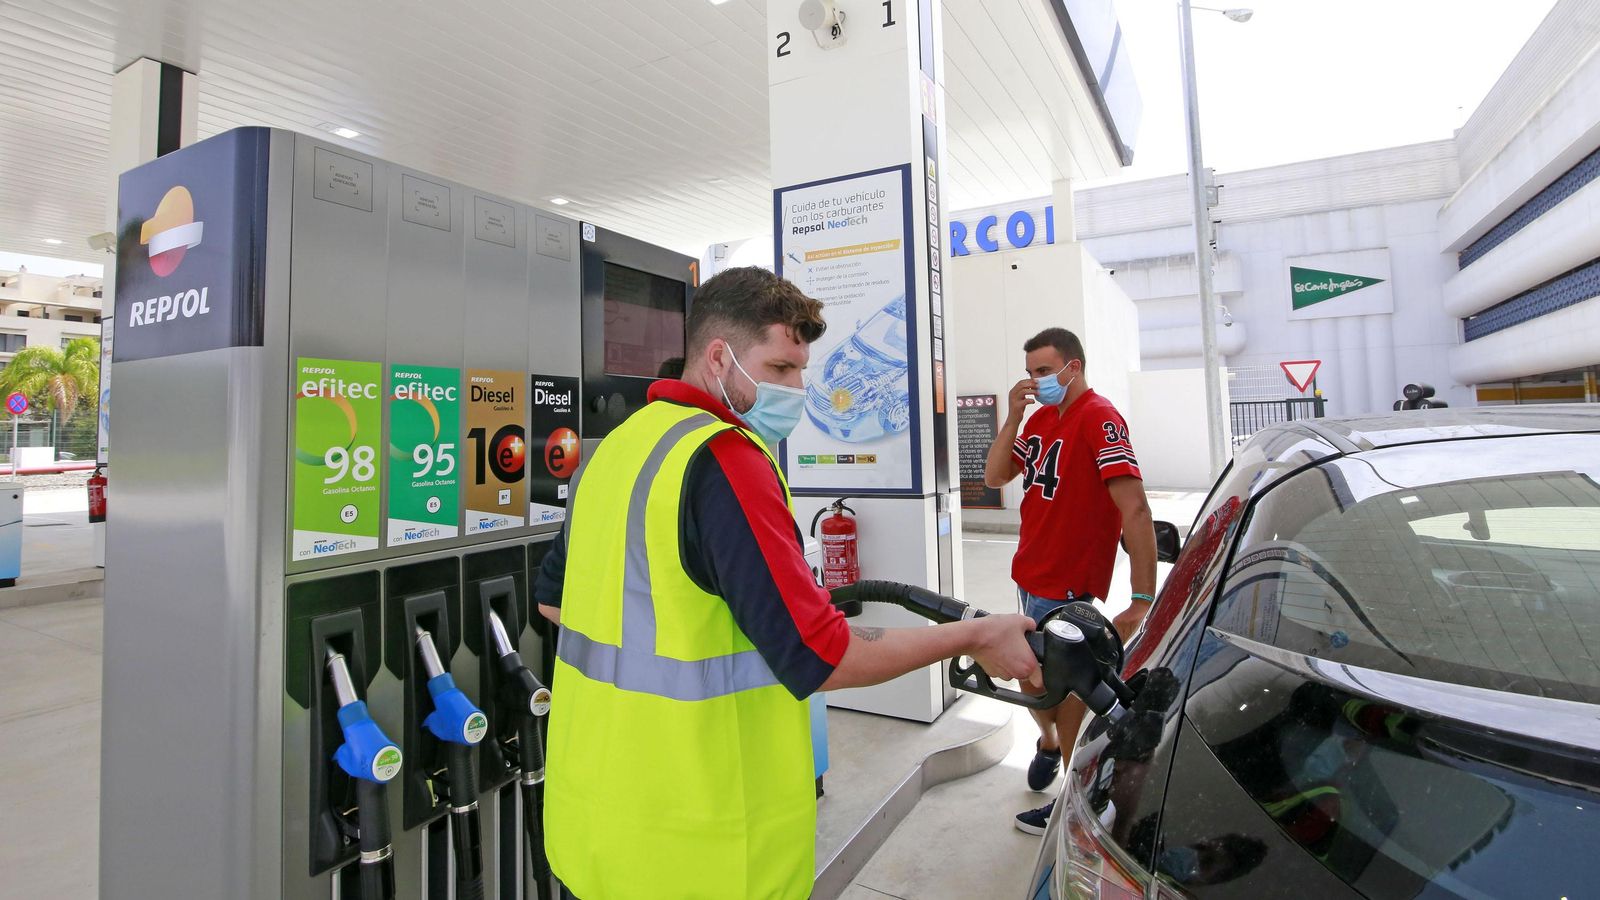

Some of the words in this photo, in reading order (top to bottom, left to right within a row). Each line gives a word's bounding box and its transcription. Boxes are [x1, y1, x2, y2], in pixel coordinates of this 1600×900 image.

[882, 0, 896, 28] 1
[776, 31, 791, 58] 2
[792, 202, 816, 214] Cuida
[818, 199, 830, 209] de
[832, 197, 842, 207] tu
[844, 189, 886, 204] vehículo
[792, 215, 808, 225] con
[810, 211, 824, 221] los
[826, 201, 884, 218] carburantes
[792, 221, 825, 236] Repsol
[827, 215, 868, 230] NeoTech
[689, 262, 698, 288] 1
[1294, 283, 1305, 293] El
[129, 287, 210, 328] REPSOL
[302, 367, 336, 375] REPSOL
[395, 372, 422, 380] REPSOL
[301, 378, 377, 400] efitec
[394, 382, 457, 401] efitec
[471, 385, 514, 403] Diesel
[535, 388, 571, 406] Diesel
[1102, 421, 1131, 445] 34
[324, 445, 375, 485] 98
[413, 443, 456, 478] 95
[1023, 434, 1063, 500] 34
[323, 487, 350, 495] Gasolina
[350, 485, 376, 493] Octanos
[404, 527, 440, 541] NeoTech
[479, 518, 509, 530] NeoTech
[313, 539, 356, 554] NeoTech
[1073, 605, 1097, 620] DIESEL
